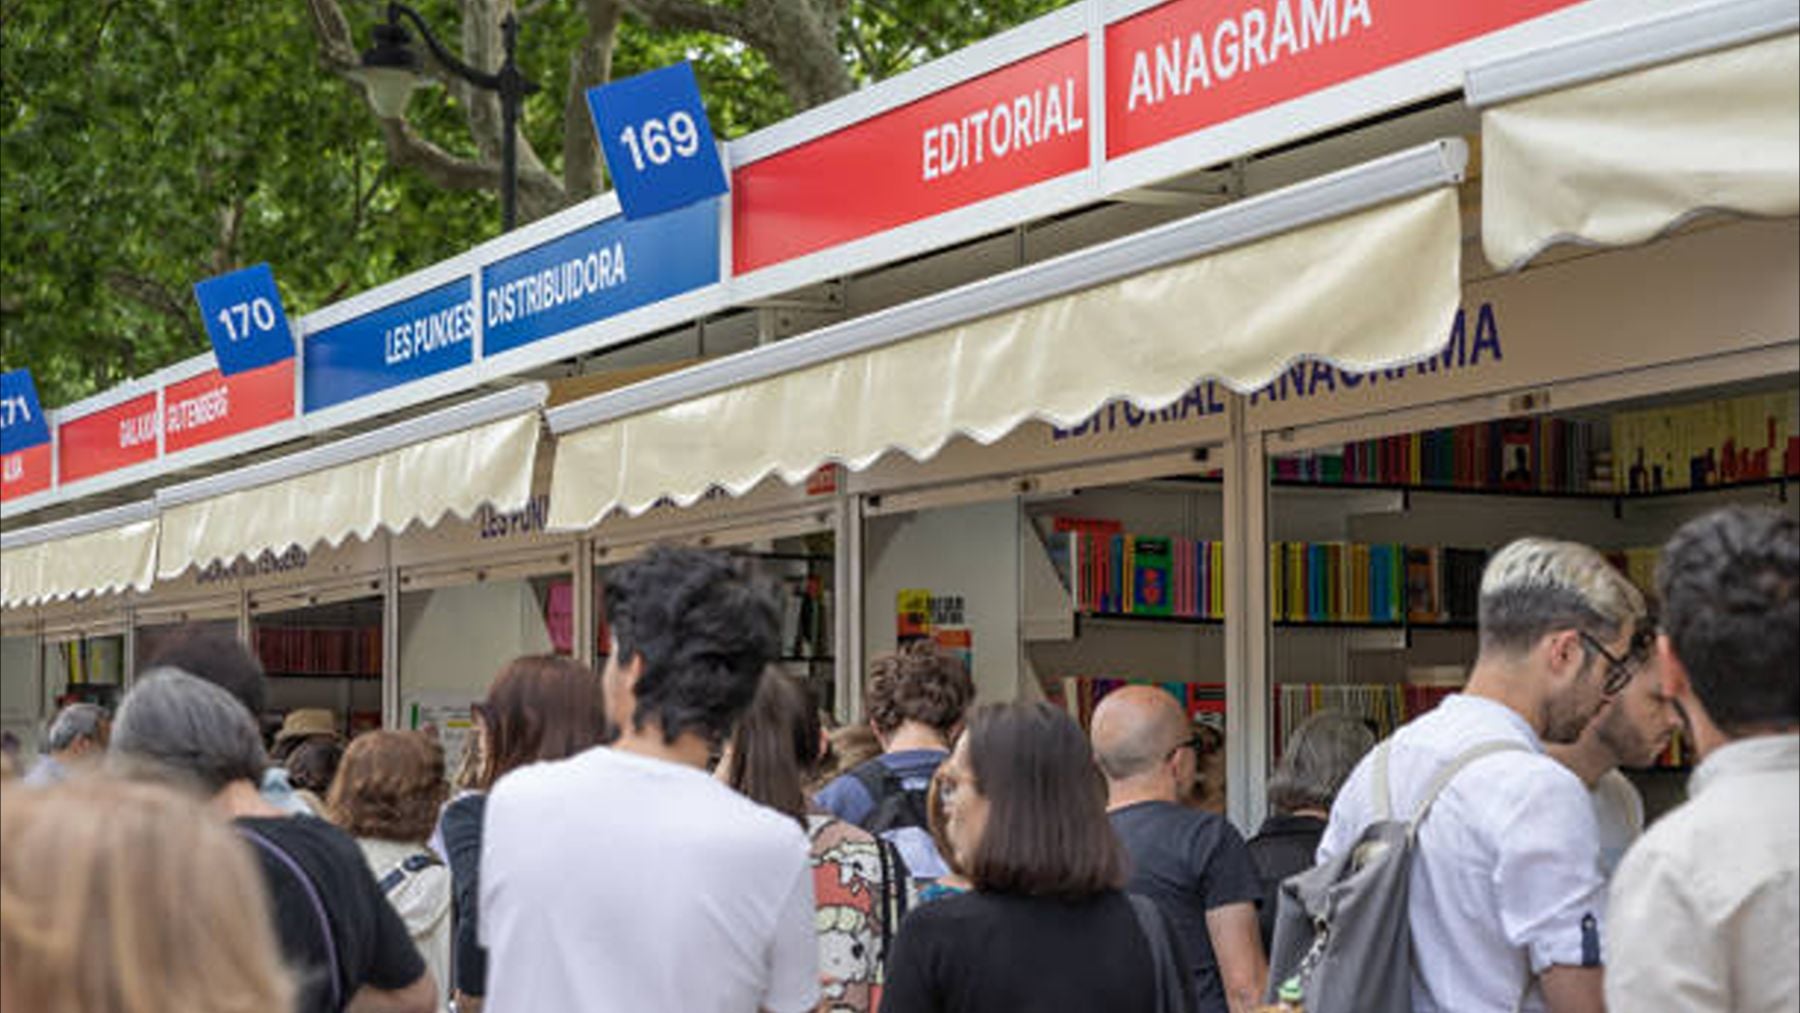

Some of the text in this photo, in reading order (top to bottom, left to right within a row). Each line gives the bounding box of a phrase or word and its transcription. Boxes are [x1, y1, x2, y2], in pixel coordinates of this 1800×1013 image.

[922, 0, 1372, 181] EDITORIAL ANAGRAMA
[620, 111, 699, 171] 169
[219, 297, 275, 341] 170
[384, 242, 627, 365] LES PUNXES DISTRIBUIDORA
[0, 395, 31, 428] 71
